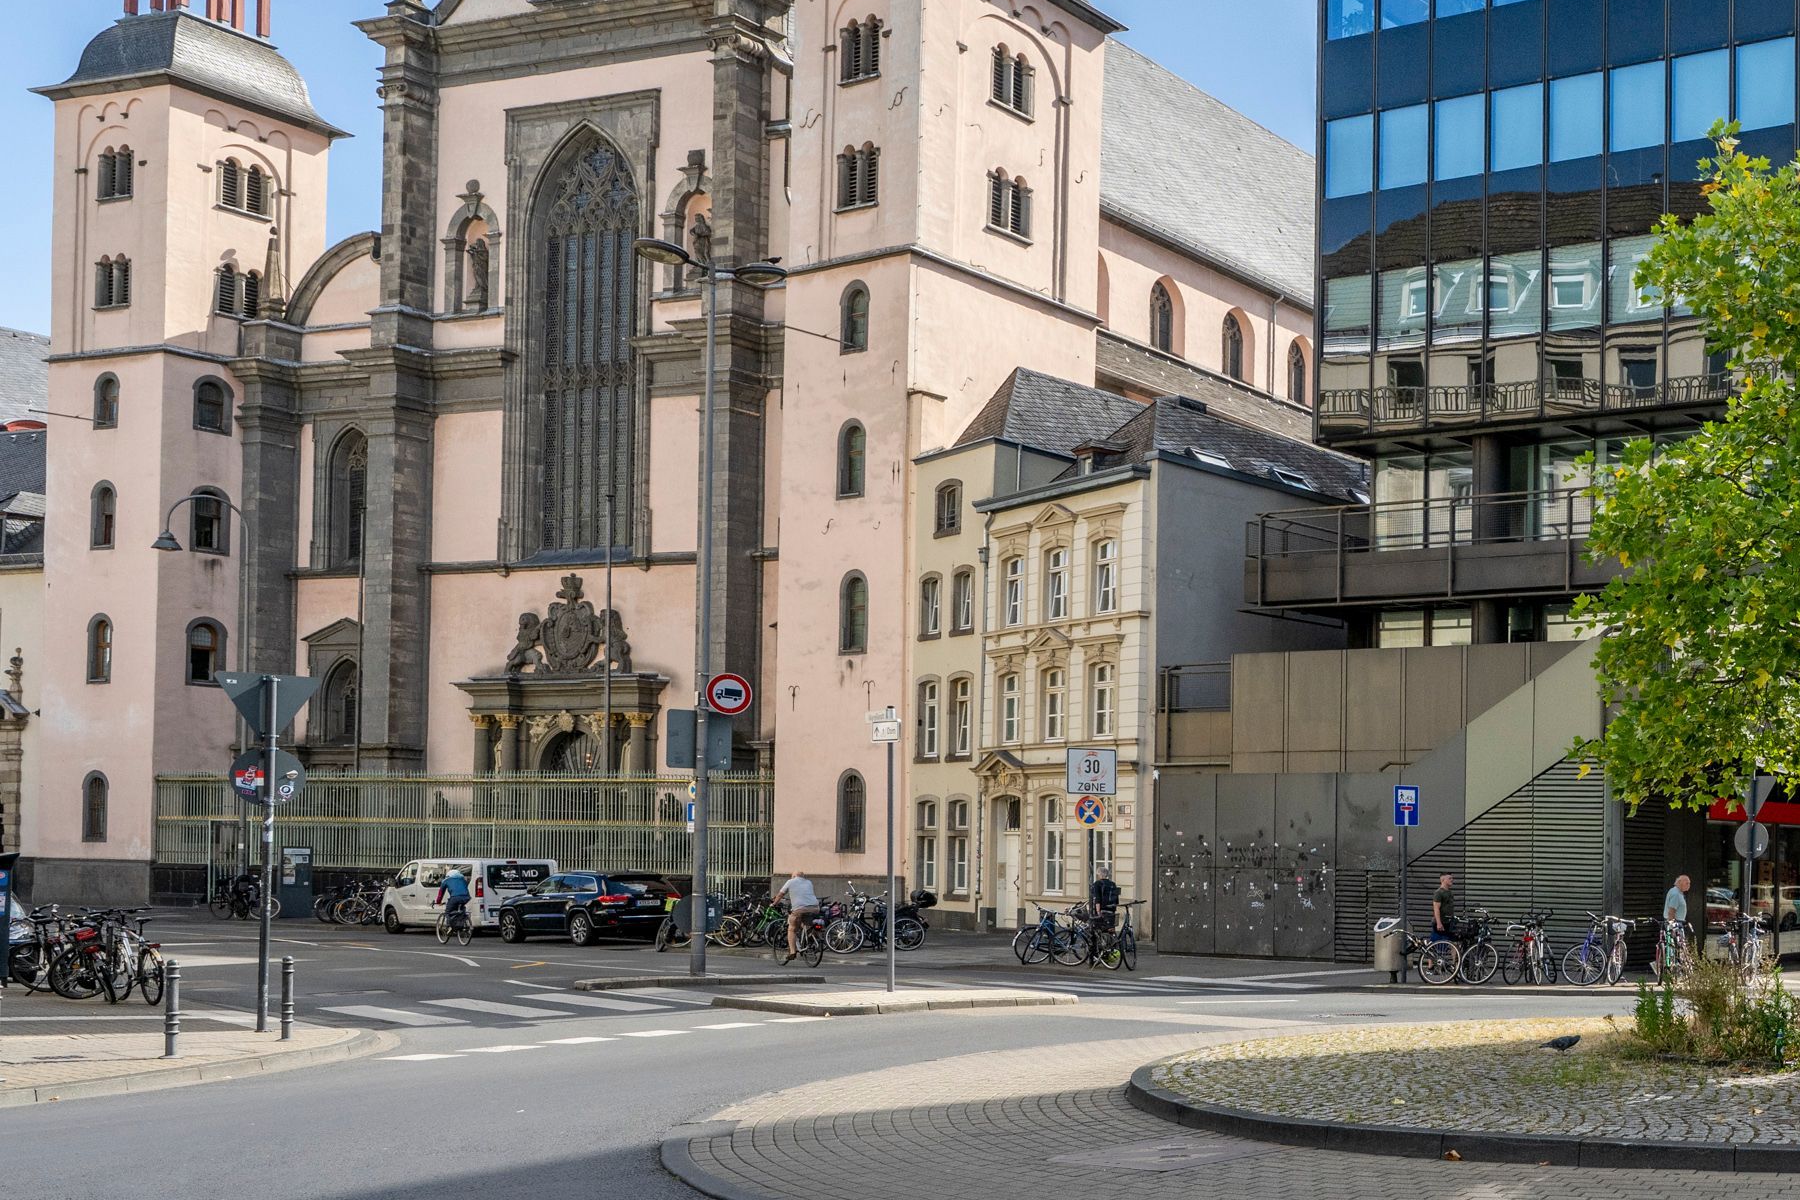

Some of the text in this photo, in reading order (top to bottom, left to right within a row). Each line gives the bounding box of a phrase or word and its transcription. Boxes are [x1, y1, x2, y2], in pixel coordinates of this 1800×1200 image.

[1084, 759, 1100, 774] 30
[1077, 782, 1106, 792] ZONE
[521, 869, 539, 878] MD
